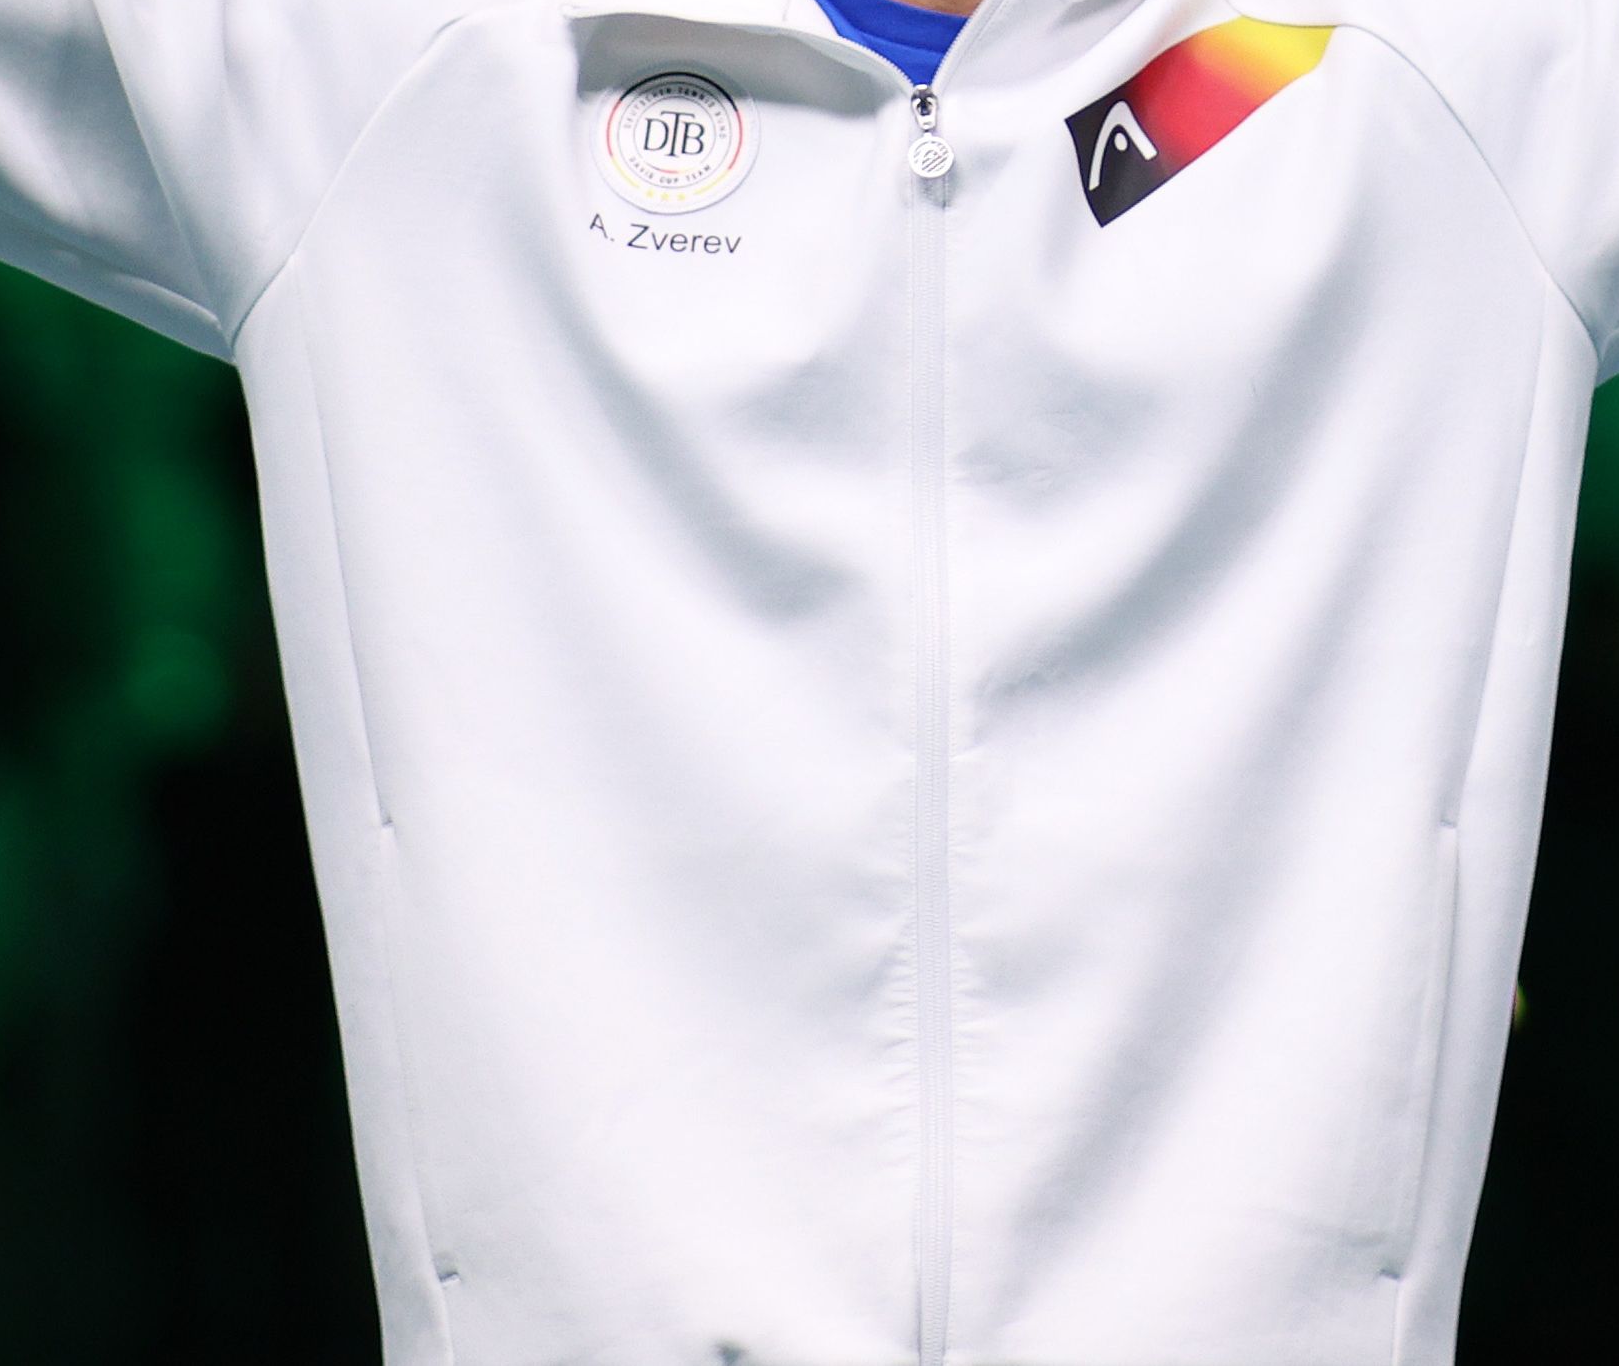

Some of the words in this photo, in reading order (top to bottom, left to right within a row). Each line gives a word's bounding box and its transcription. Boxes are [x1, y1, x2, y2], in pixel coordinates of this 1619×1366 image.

[642, 110, 706, 159] DTB
[589, 213, 614, 242] A.
[627, 223, 741, 254] Zverev
